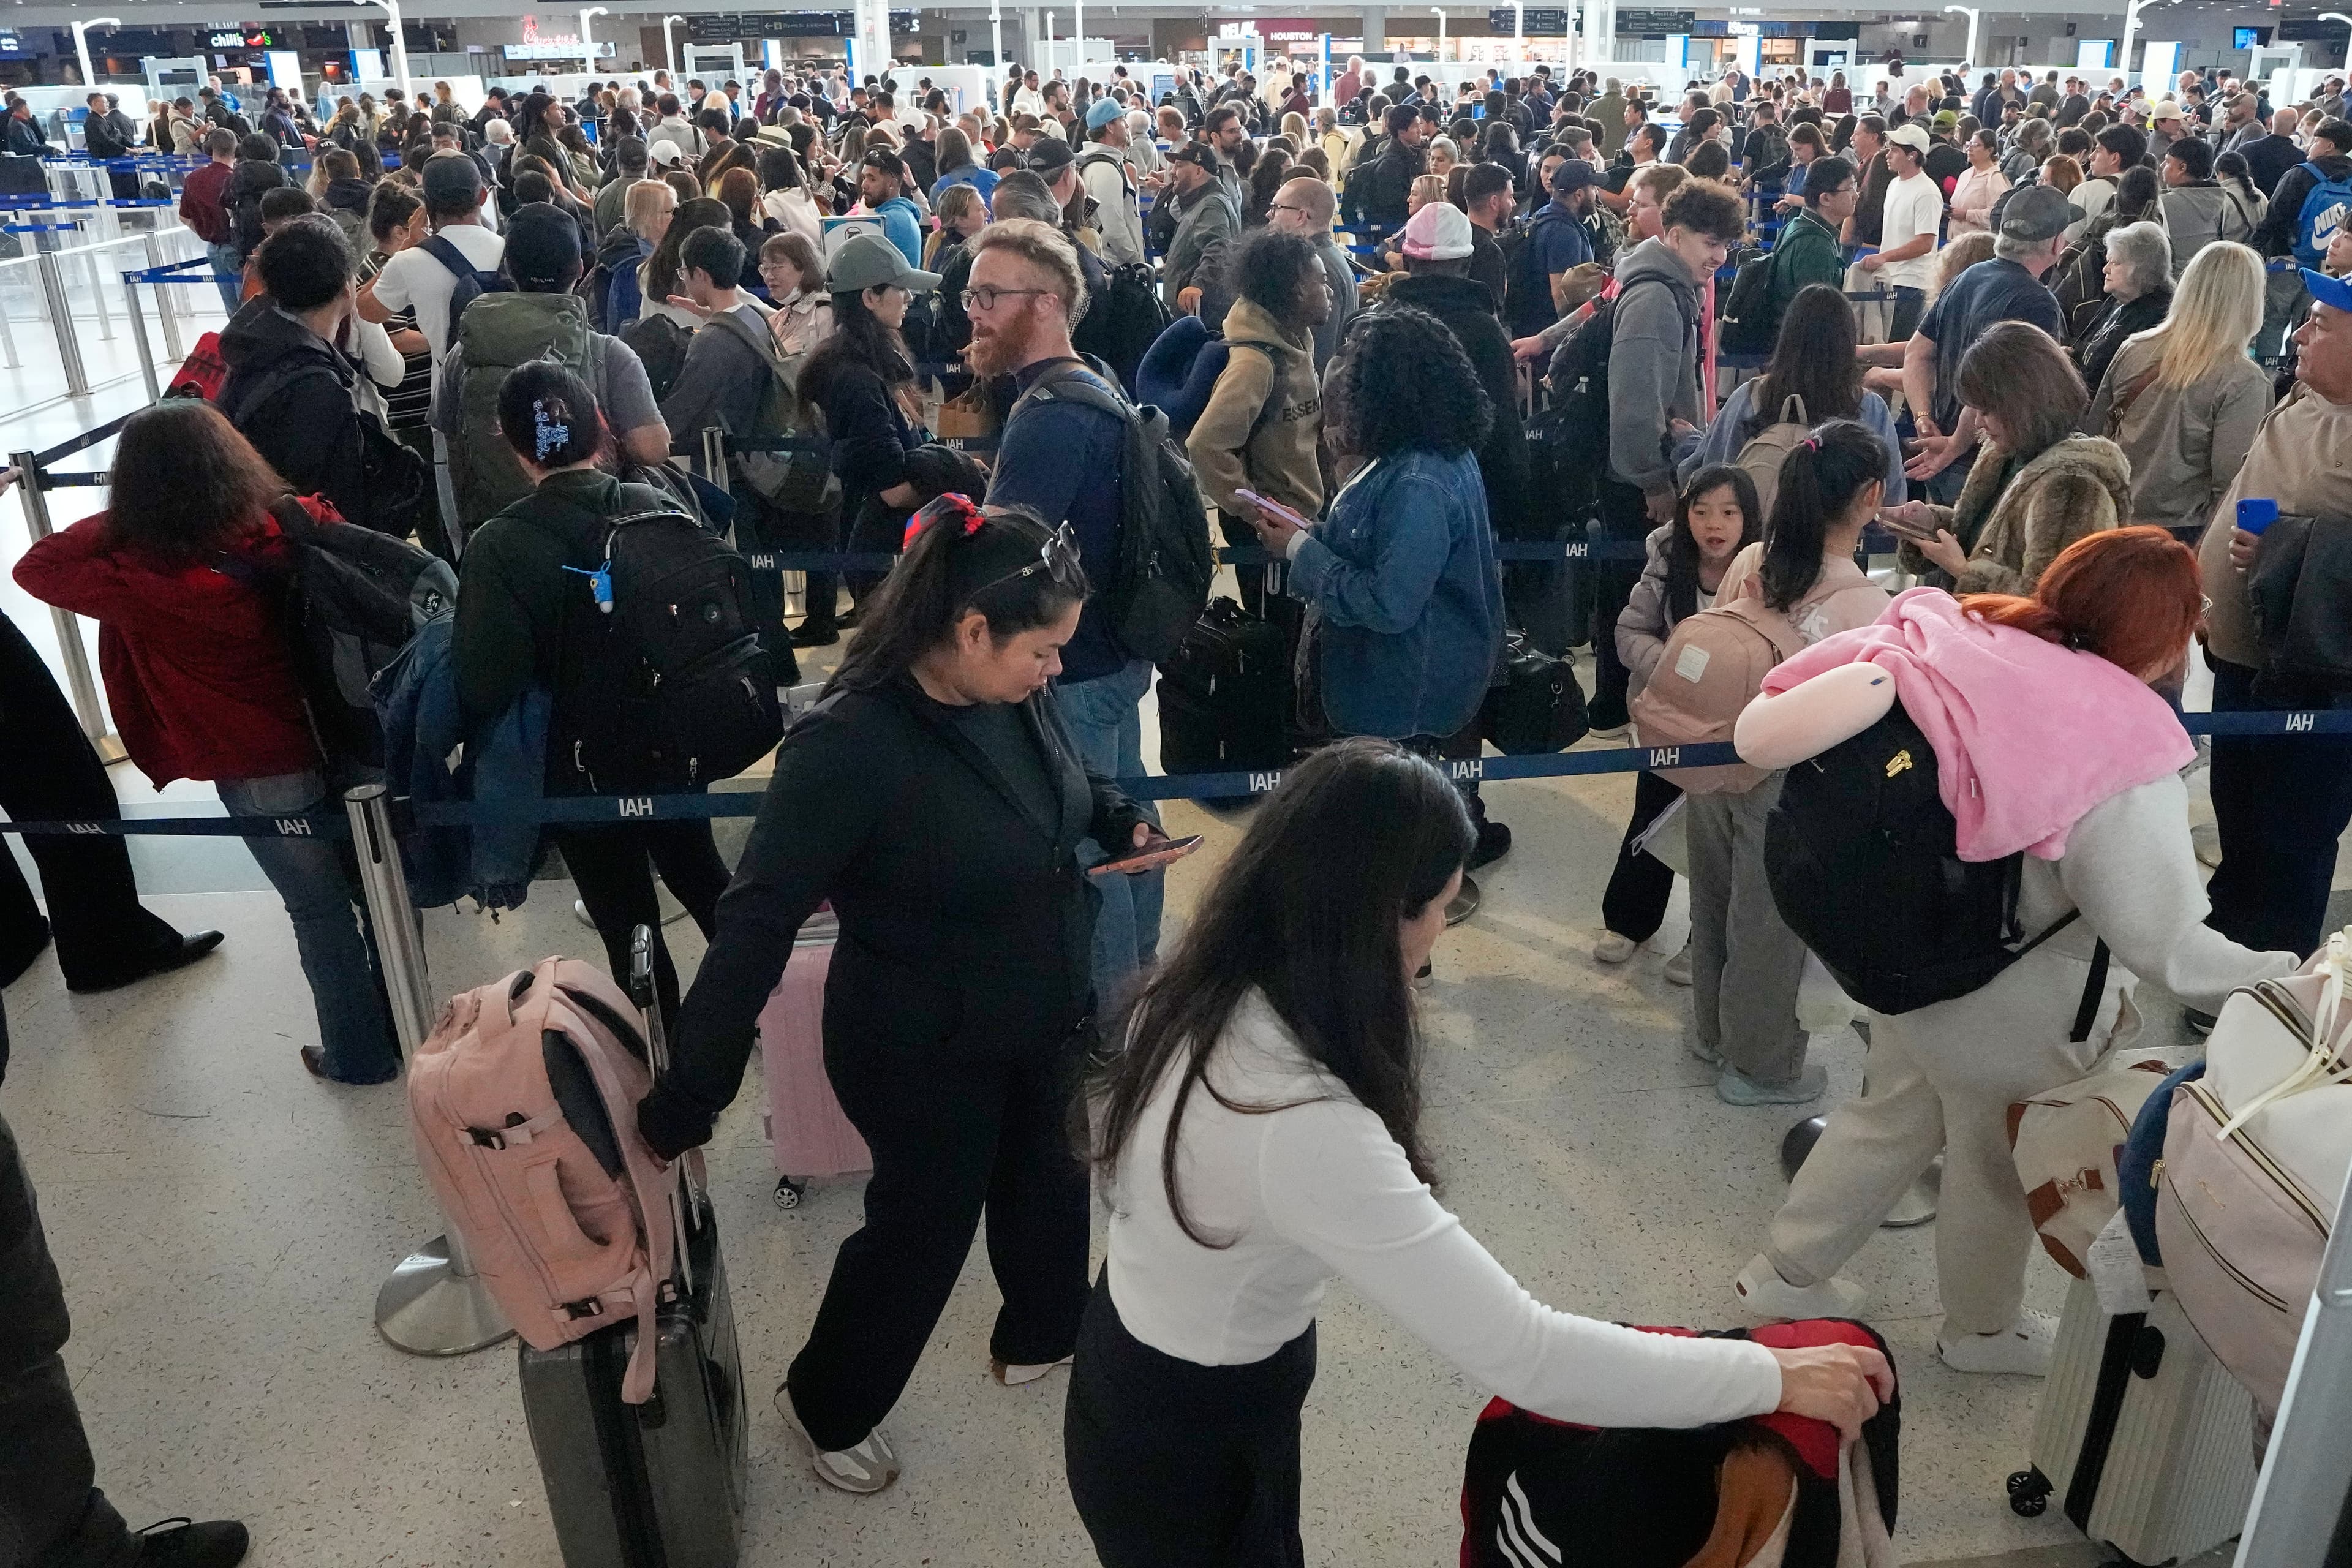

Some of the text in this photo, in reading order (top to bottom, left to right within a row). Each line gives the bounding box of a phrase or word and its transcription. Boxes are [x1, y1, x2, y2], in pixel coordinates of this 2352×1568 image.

[211, 33, 244, 47] chili's
[1270, 32, 1313, 41] HOUSTON
[946, 364, 961, 373] IAH
[2265, 357, 2278, 366] IAH
[1525, 429, 1544, 440] IAH
[946, 439, 963, 450] IAH
[1566, 543, 1588, 557] IAH
[752, 554, 774, 568] IAH
[2285, 714, 2315, 731] IAH
[1650, 748, 1679, 766] IAH
[1453, 760, 1483, 779] IAH
[1250, 772, 1280, 791] IAH
[619, 797, 653, 816] IAH
[66, 823, 107, 834] IAH
[274, 819, 311, 835] IAH
